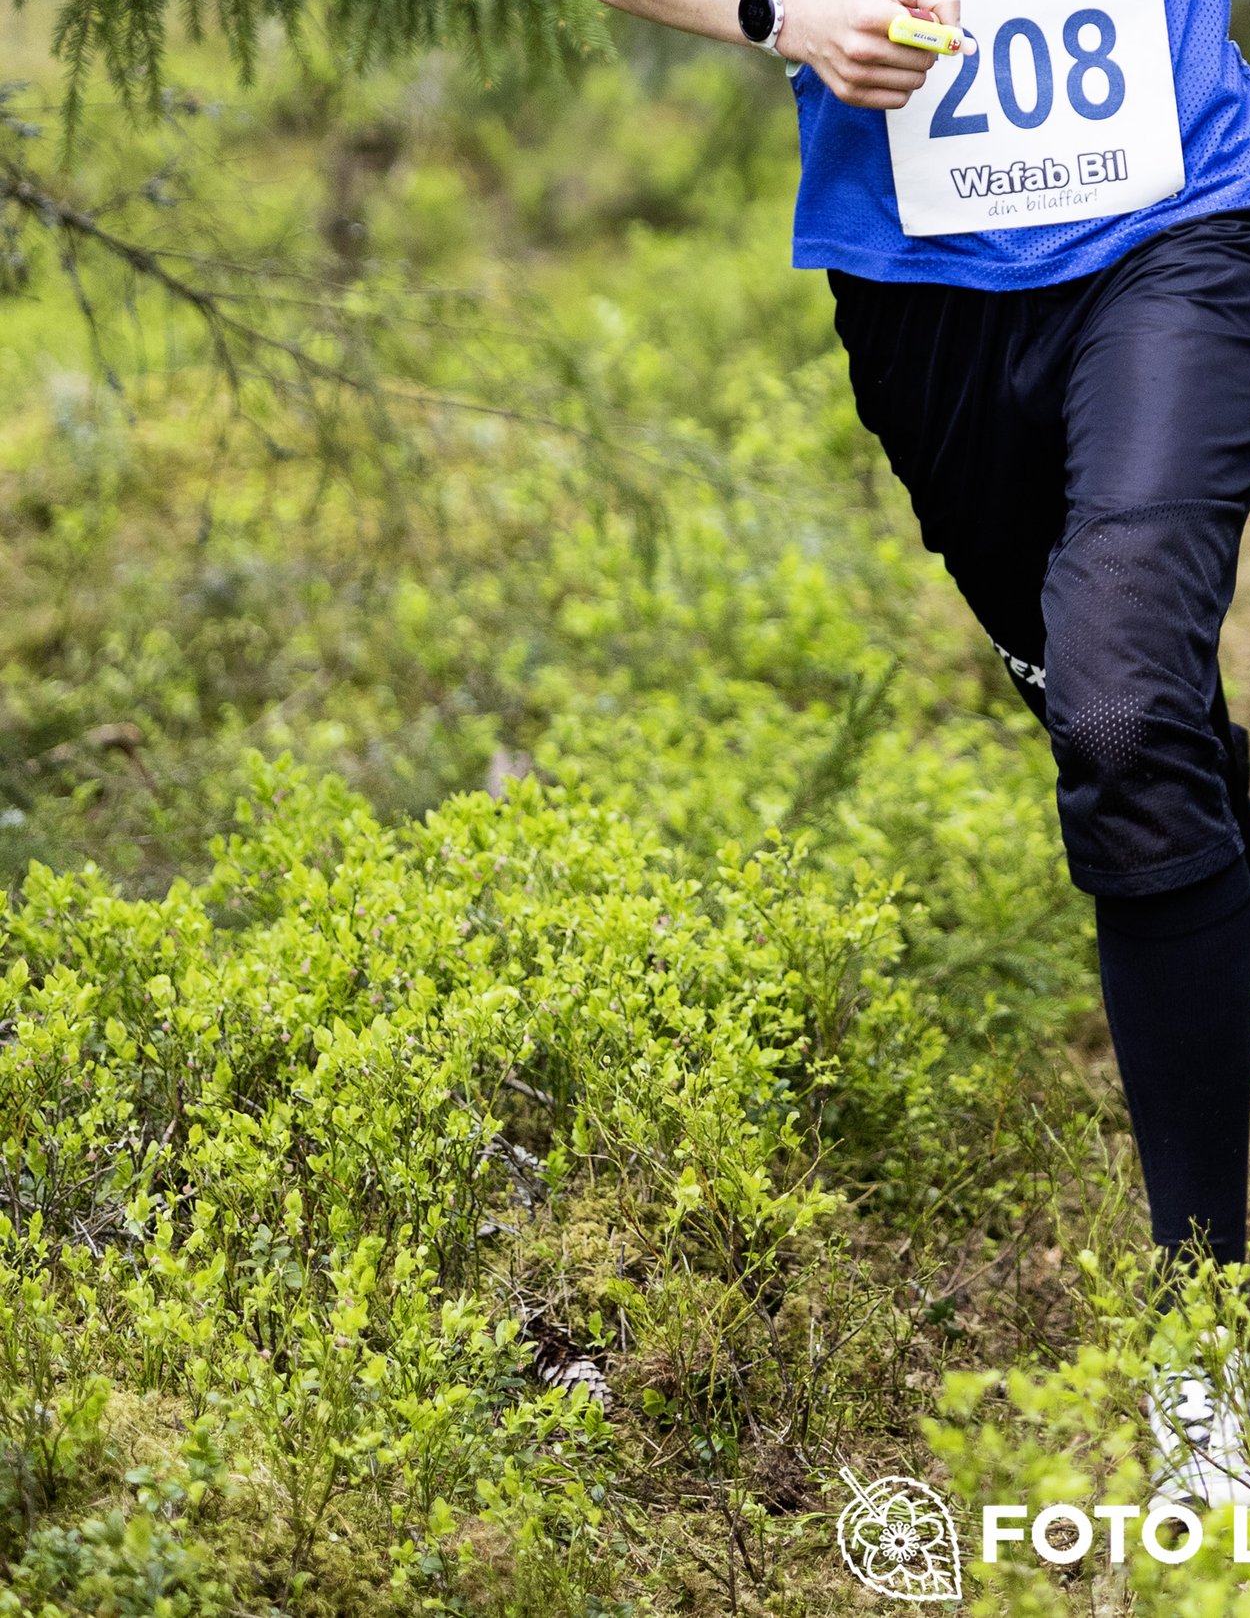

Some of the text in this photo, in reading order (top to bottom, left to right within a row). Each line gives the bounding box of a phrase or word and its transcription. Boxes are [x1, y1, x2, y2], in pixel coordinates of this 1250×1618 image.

[929, 8, 1126, 139] 208
[950, 149, 1129, 199] Wafab Bil
[988, 188, 1098, 217] din bilaffär!
